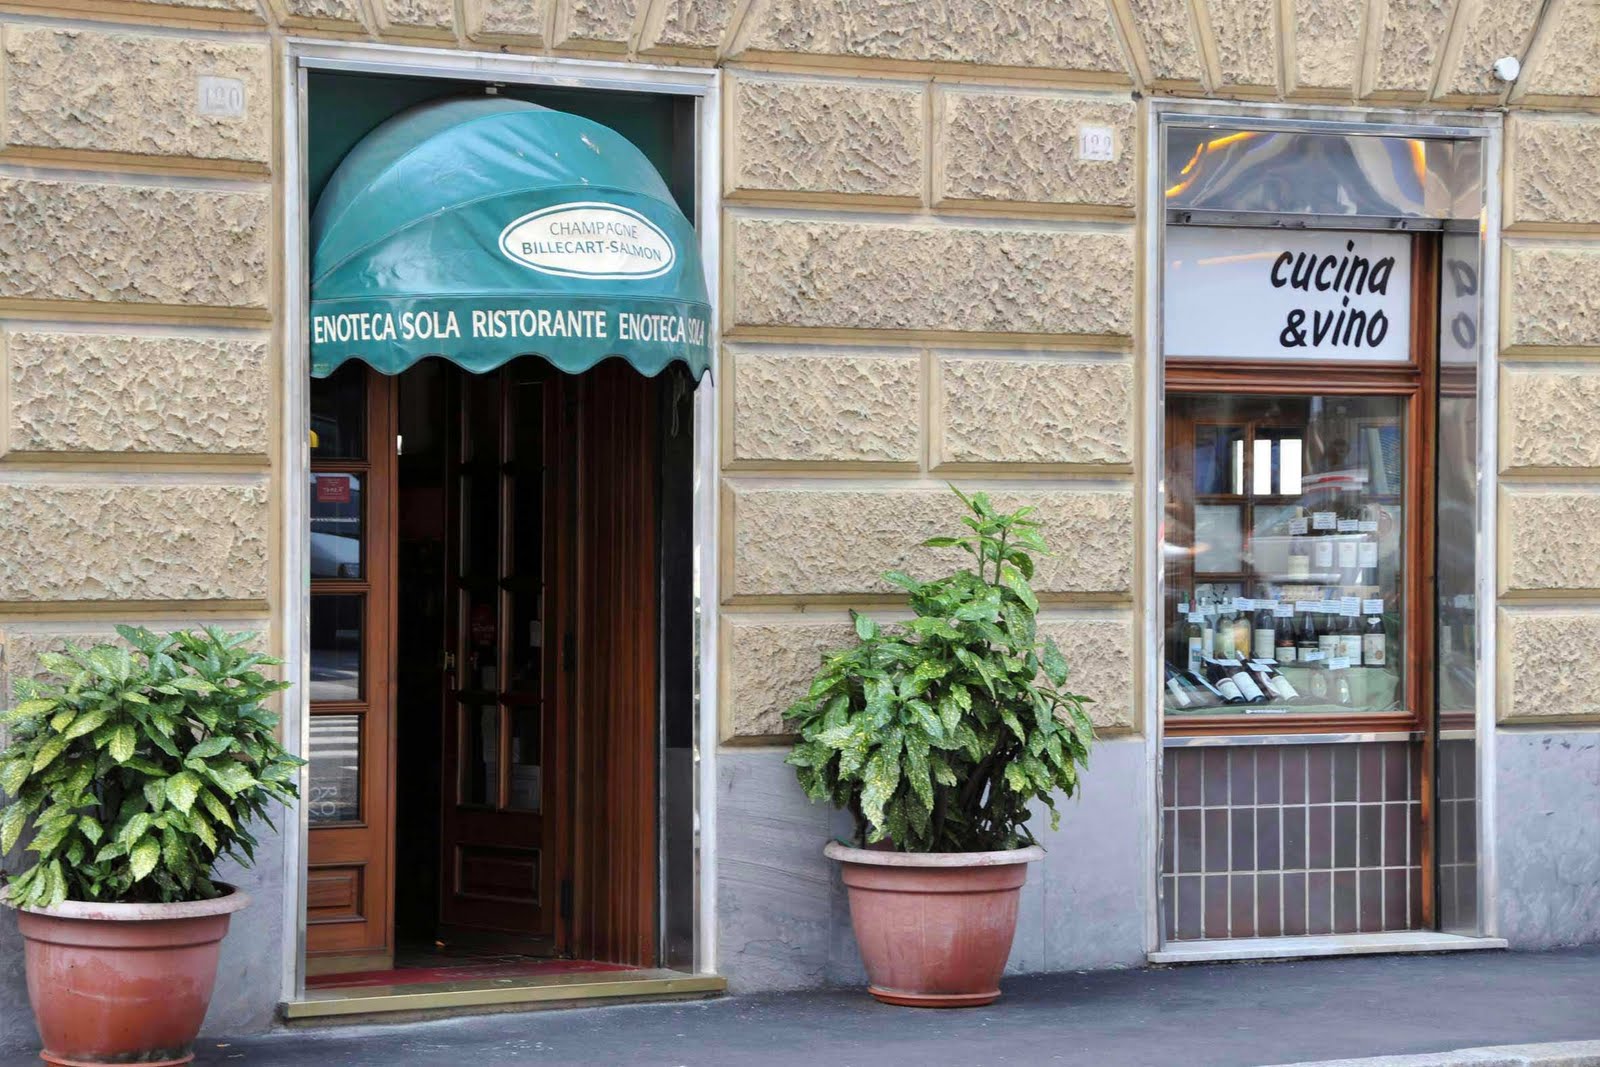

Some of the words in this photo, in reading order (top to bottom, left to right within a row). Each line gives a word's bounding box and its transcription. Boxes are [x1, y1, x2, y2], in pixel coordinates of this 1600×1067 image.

[549, 221, 638, 239] CHAMPAGNE
[521, 240, 662, 262] BILLECART-SALMON
[1270, 240, 1395, 296] cucina
[313, 312, 398, 344] ENOTECA
[402, 310, 462, 340] SOLA
[472, 309, 607, 338] RISTORANTE
[619, 312, 687, 343] ENOTECA
[688, 317, 705, 346] SOLA
[1279, 295, 1389, 348] &vino
